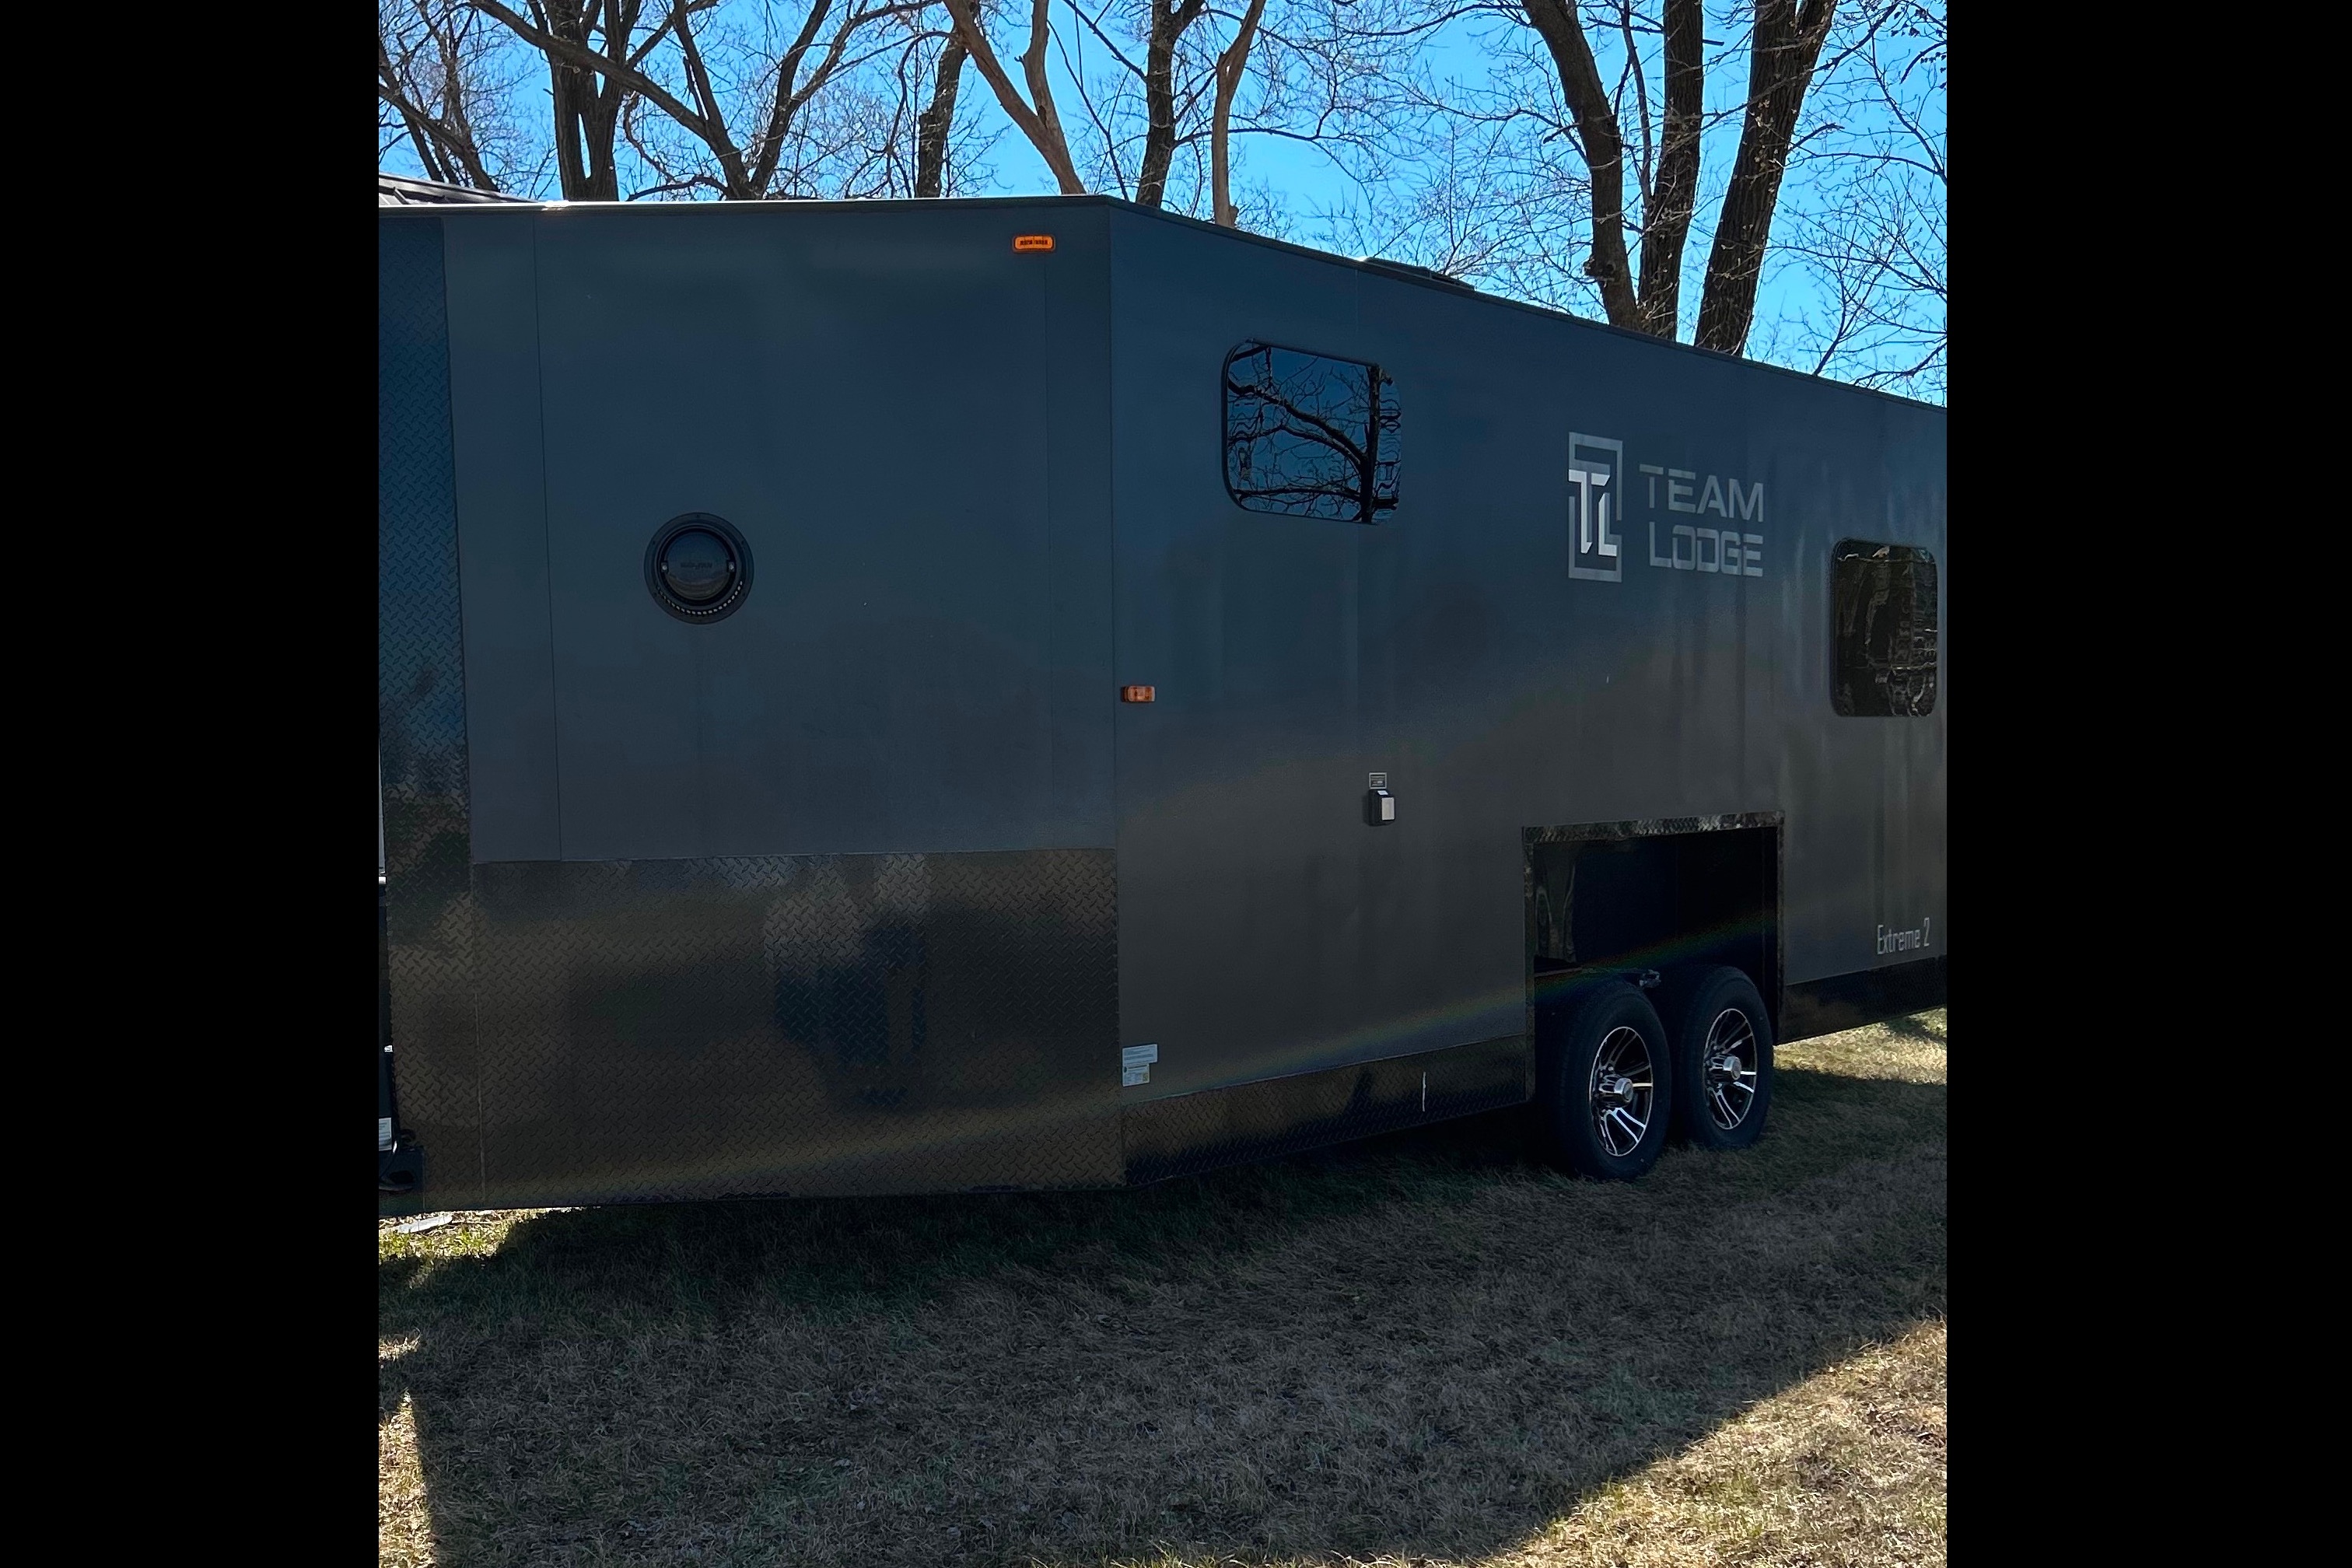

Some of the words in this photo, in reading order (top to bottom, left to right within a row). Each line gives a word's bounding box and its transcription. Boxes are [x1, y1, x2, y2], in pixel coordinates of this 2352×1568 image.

[1638, 464, 1764, 523] TEAM
[1648, 521, 1764, 577] LODGE
[1877, 924, 1920, 955] Extreme
[1923, 917, 1930, 947] 2
